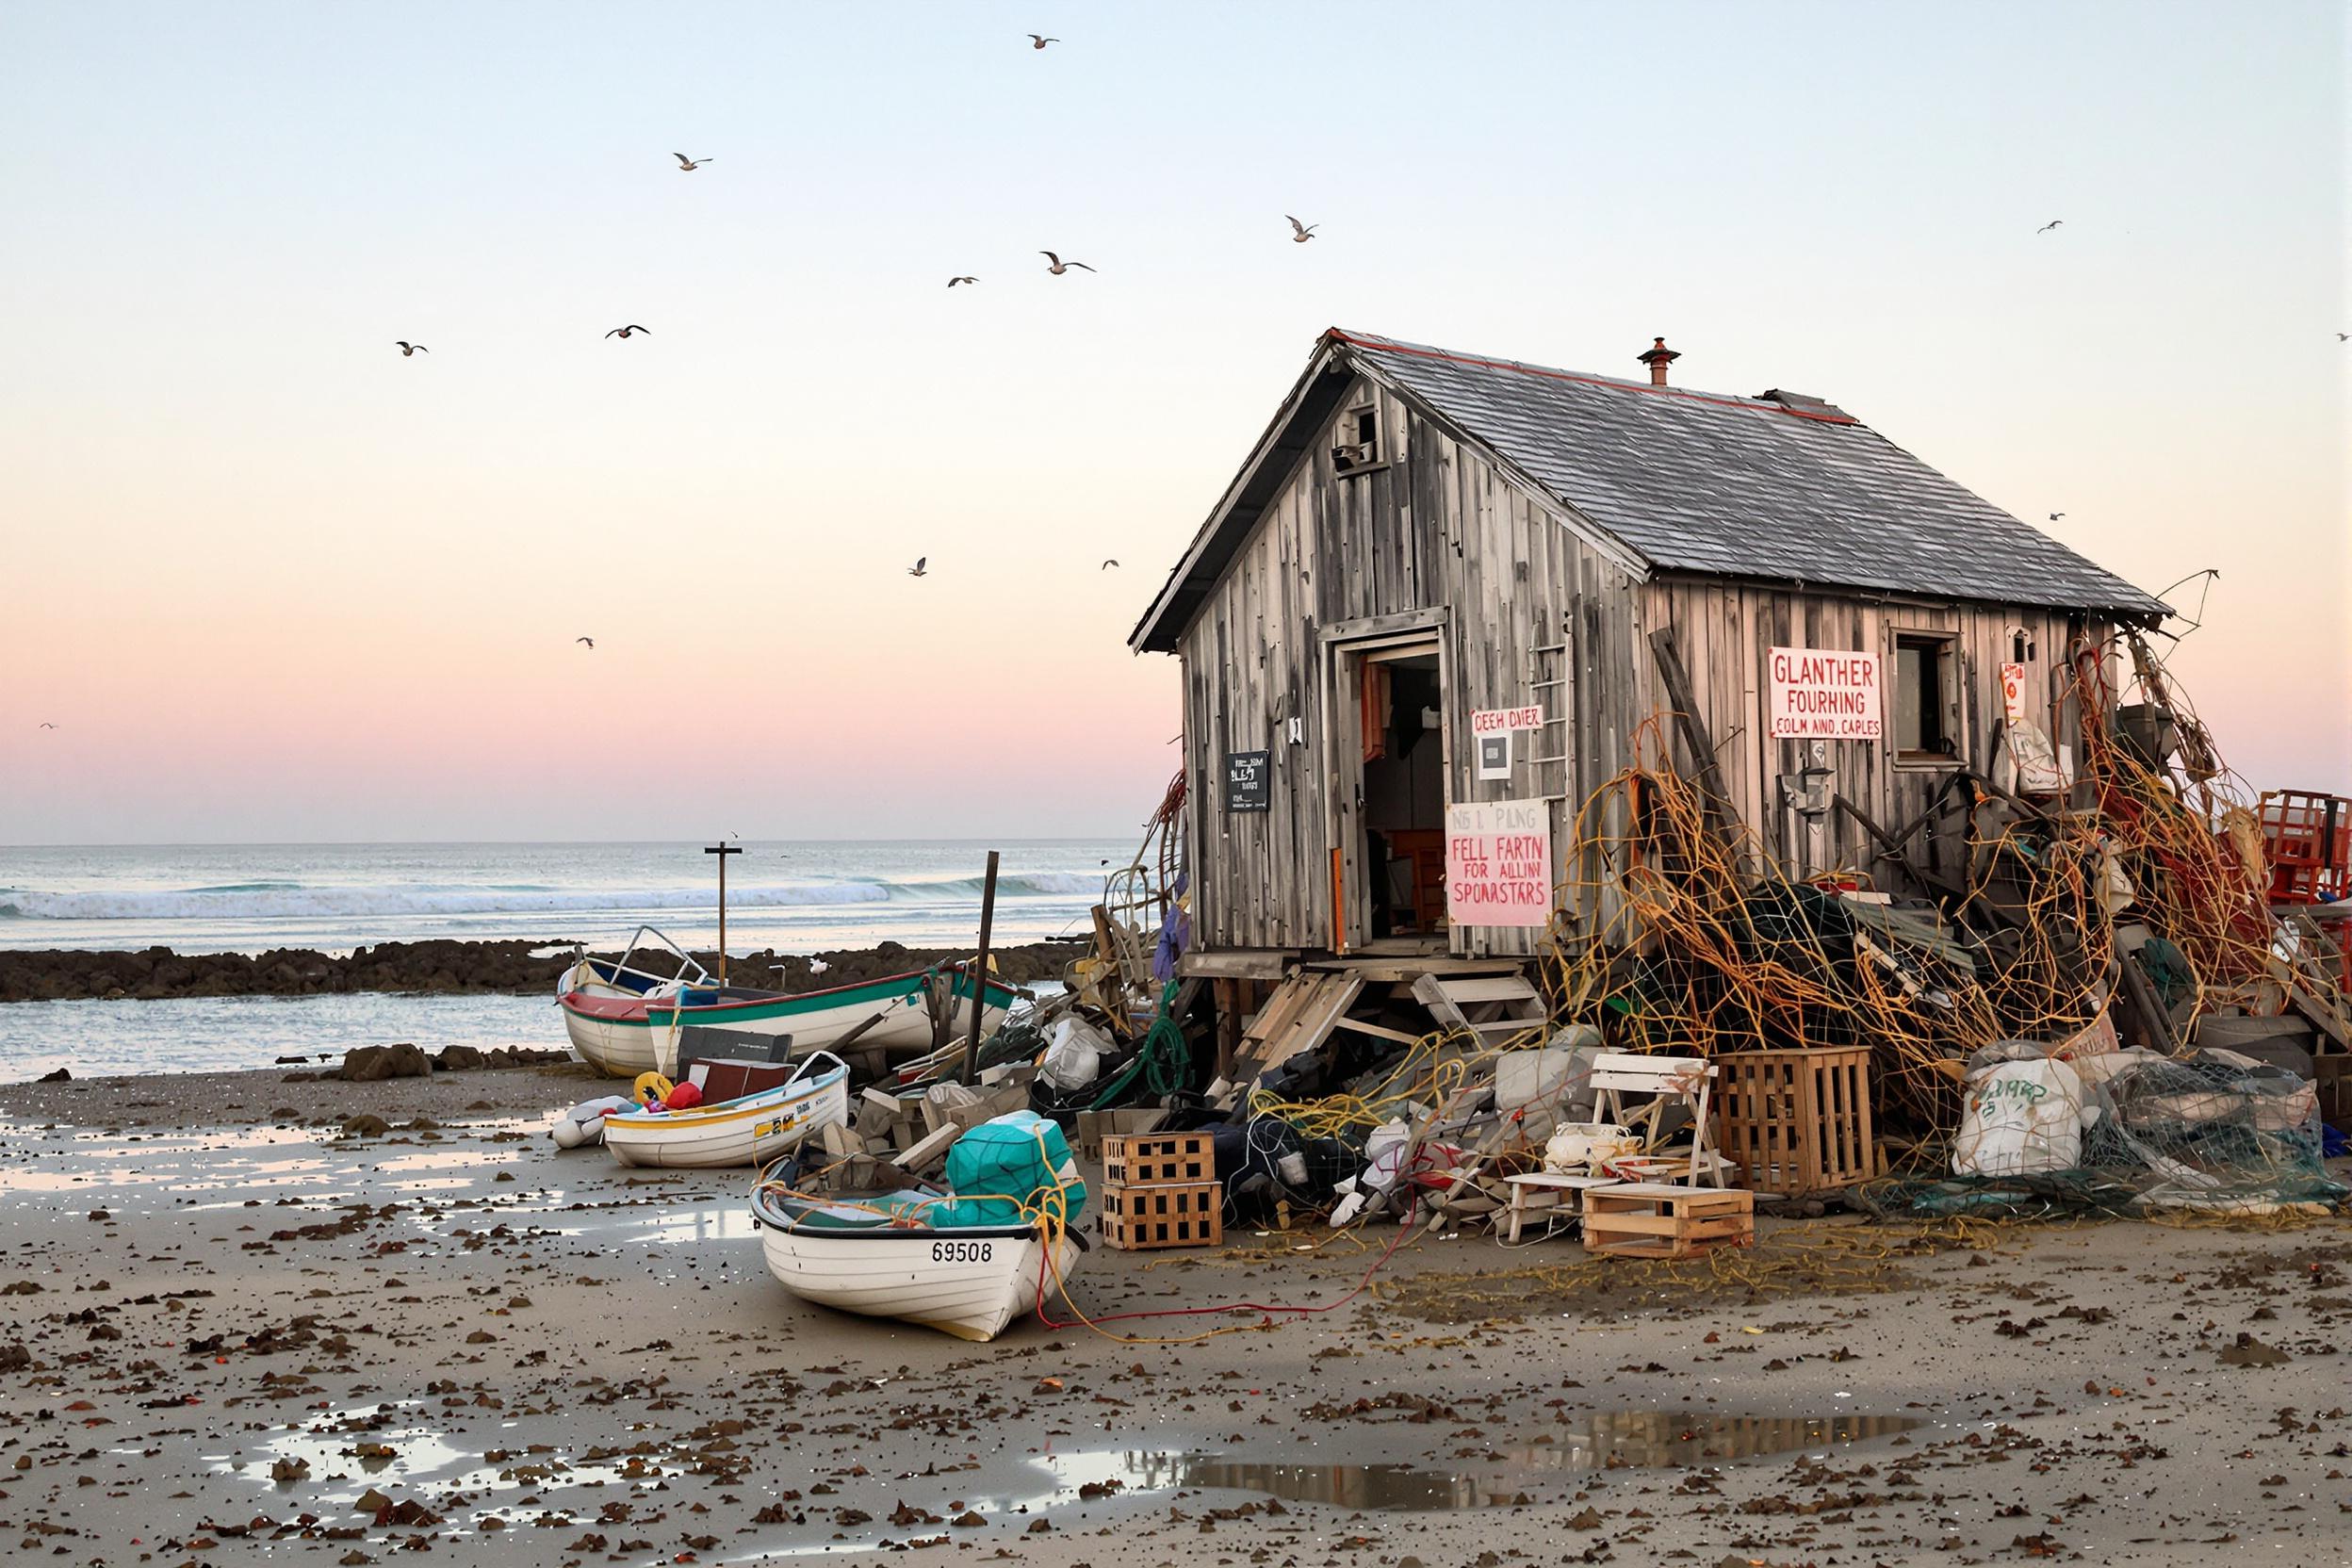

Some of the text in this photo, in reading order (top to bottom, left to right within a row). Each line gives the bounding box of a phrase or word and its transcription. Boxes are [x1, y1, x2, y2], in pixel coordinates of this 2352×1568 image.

[1774, 655, 1872, 687] GLANTHER
[1788, 690, 1865, 714] FOURHING
[1841, 719, 1880, 735] CAPLES
[1452, 836, 1544, 861] FELL FARTN
[1464, 862, 1489, 878] FOR
[932, 1242, 992, 1262] 69508
